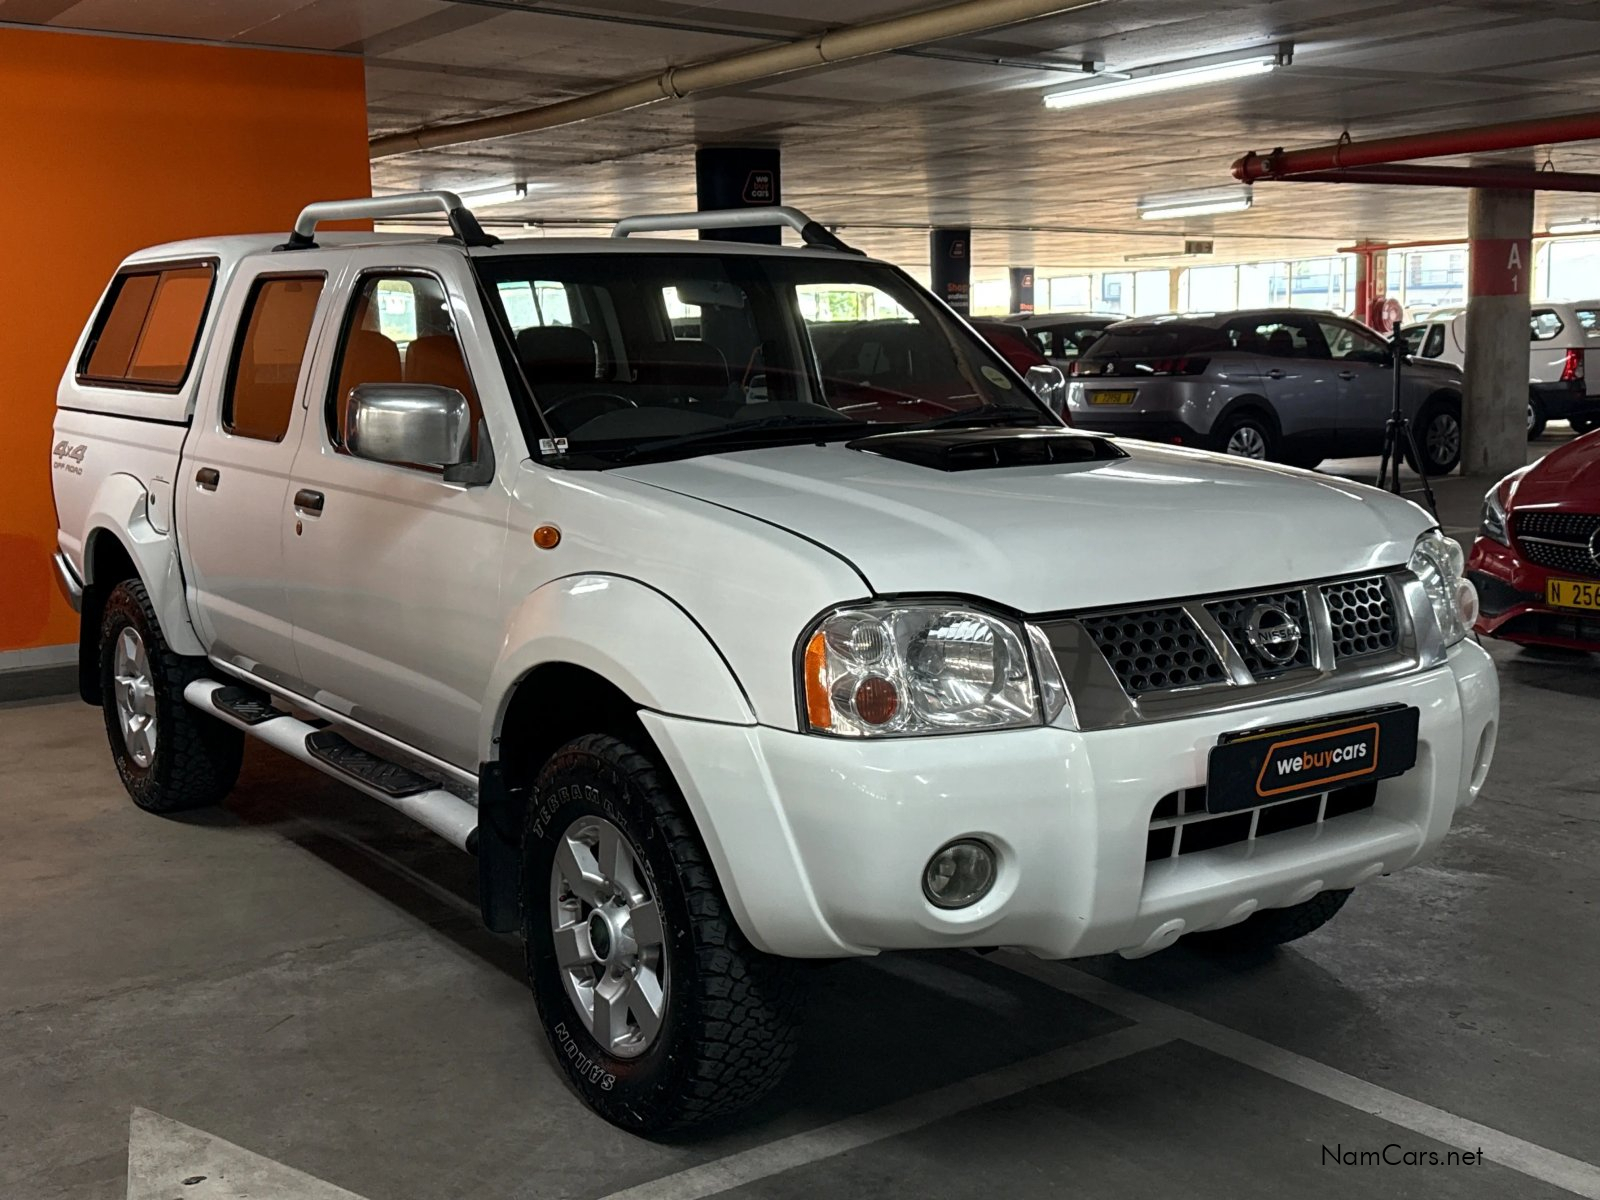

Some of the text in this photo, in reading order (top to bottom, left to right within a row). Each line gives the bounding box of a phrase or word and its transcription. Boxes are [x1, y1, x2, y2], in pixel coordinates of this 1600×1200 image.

[754, 182, 769, 190] buy
[1507, 243, 1522, 269] A
[1511, 275, 1518, 292] 1
[53, 461, 83, 476] OFF ROAD
[1551, 582, 1560, 603] N
[1276, 742, 1367, 776] webuycars
[554, 1022, 617, 1091] SAILUN
